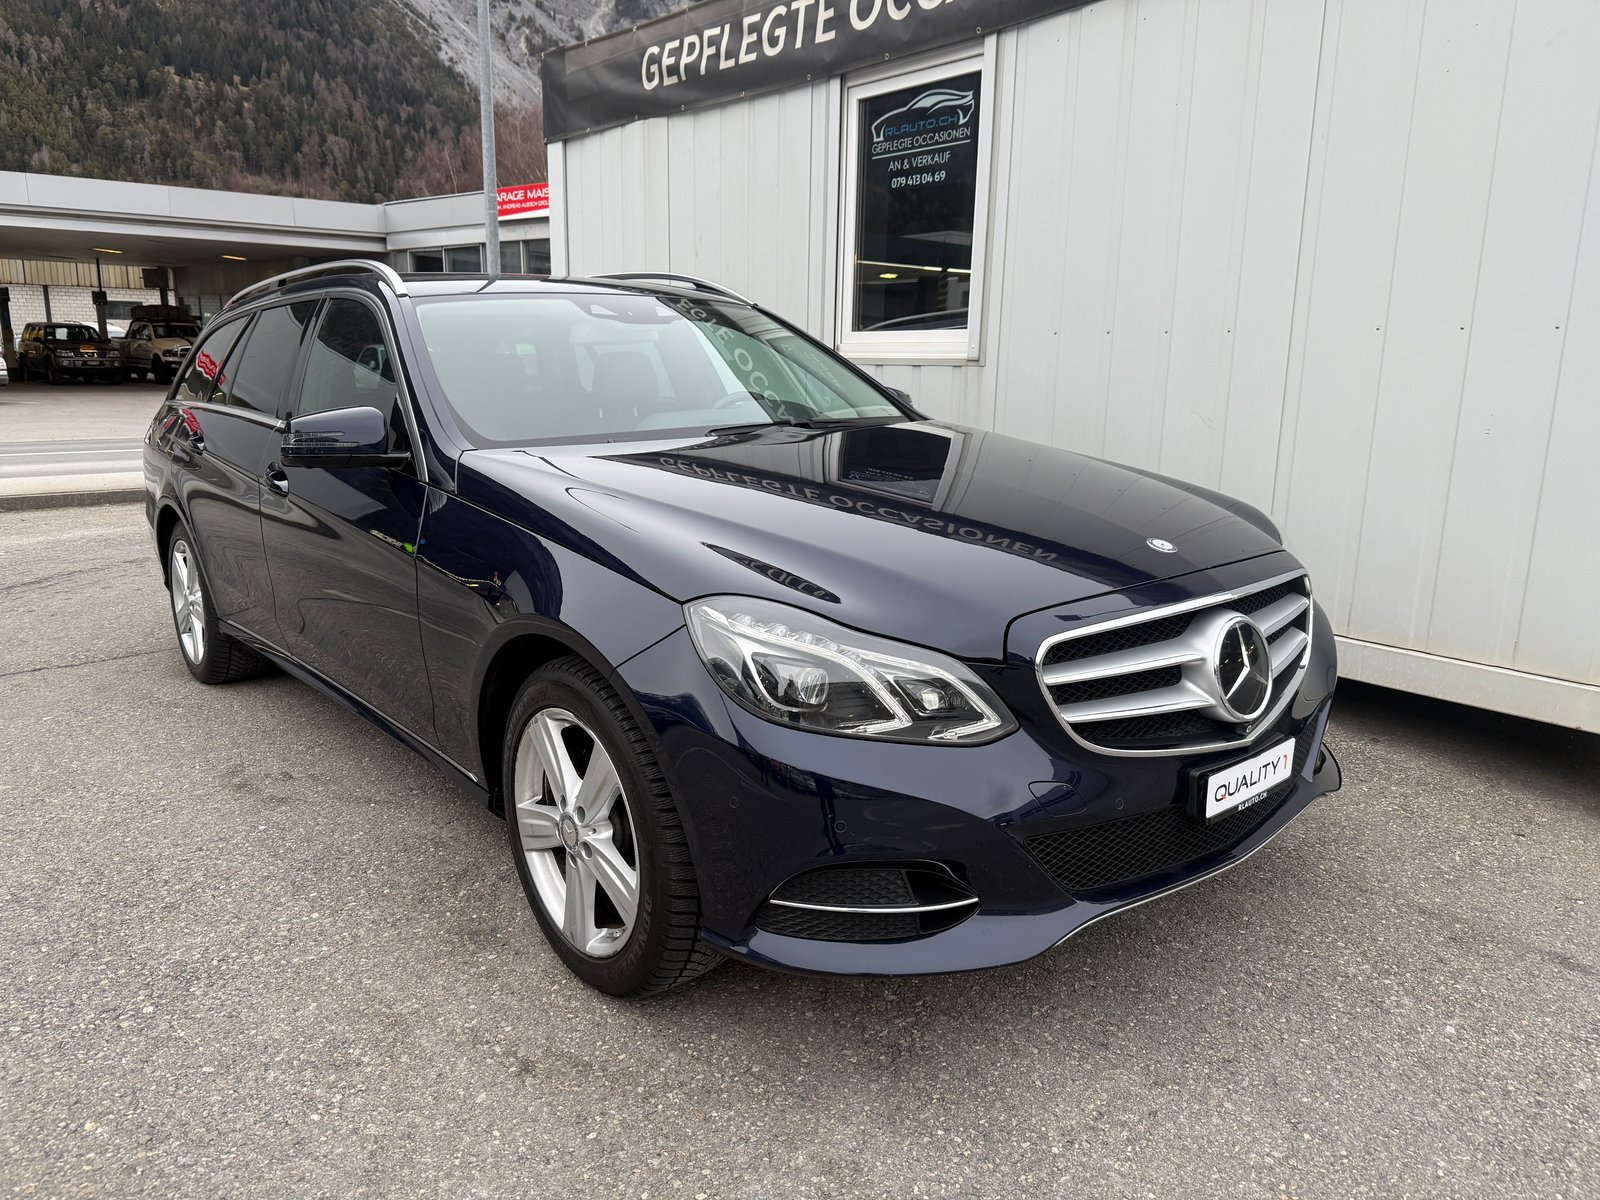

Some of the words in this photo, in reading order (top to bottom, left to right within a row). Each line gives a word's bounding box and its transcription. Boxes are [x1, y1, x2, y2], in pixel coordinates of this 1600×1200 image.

[642, 0, 836, 91] GEPFLEGTE
[885, 114, 957, 137] RLAUTO.CH
[872, 137, 913, 154] GEPFLEGTE
[913, 126, 971, 147] OCCASIONEN
[888, 160, 901, 172] AN
[903, 158, 910, 170] &
[911, 150, 952, 168] VERKAUF
[891, 176, 906, 189] 079
[907, 174, 920, 186] 413
[921, 171, 933, 184] 04
[934, 170, 946, 182] 69
[1214, 757, 1281, 802] QUALITY
[1283, 754, 1288, 769] 1
[1237, 791, 1268, 811] RLAUTO.CH
